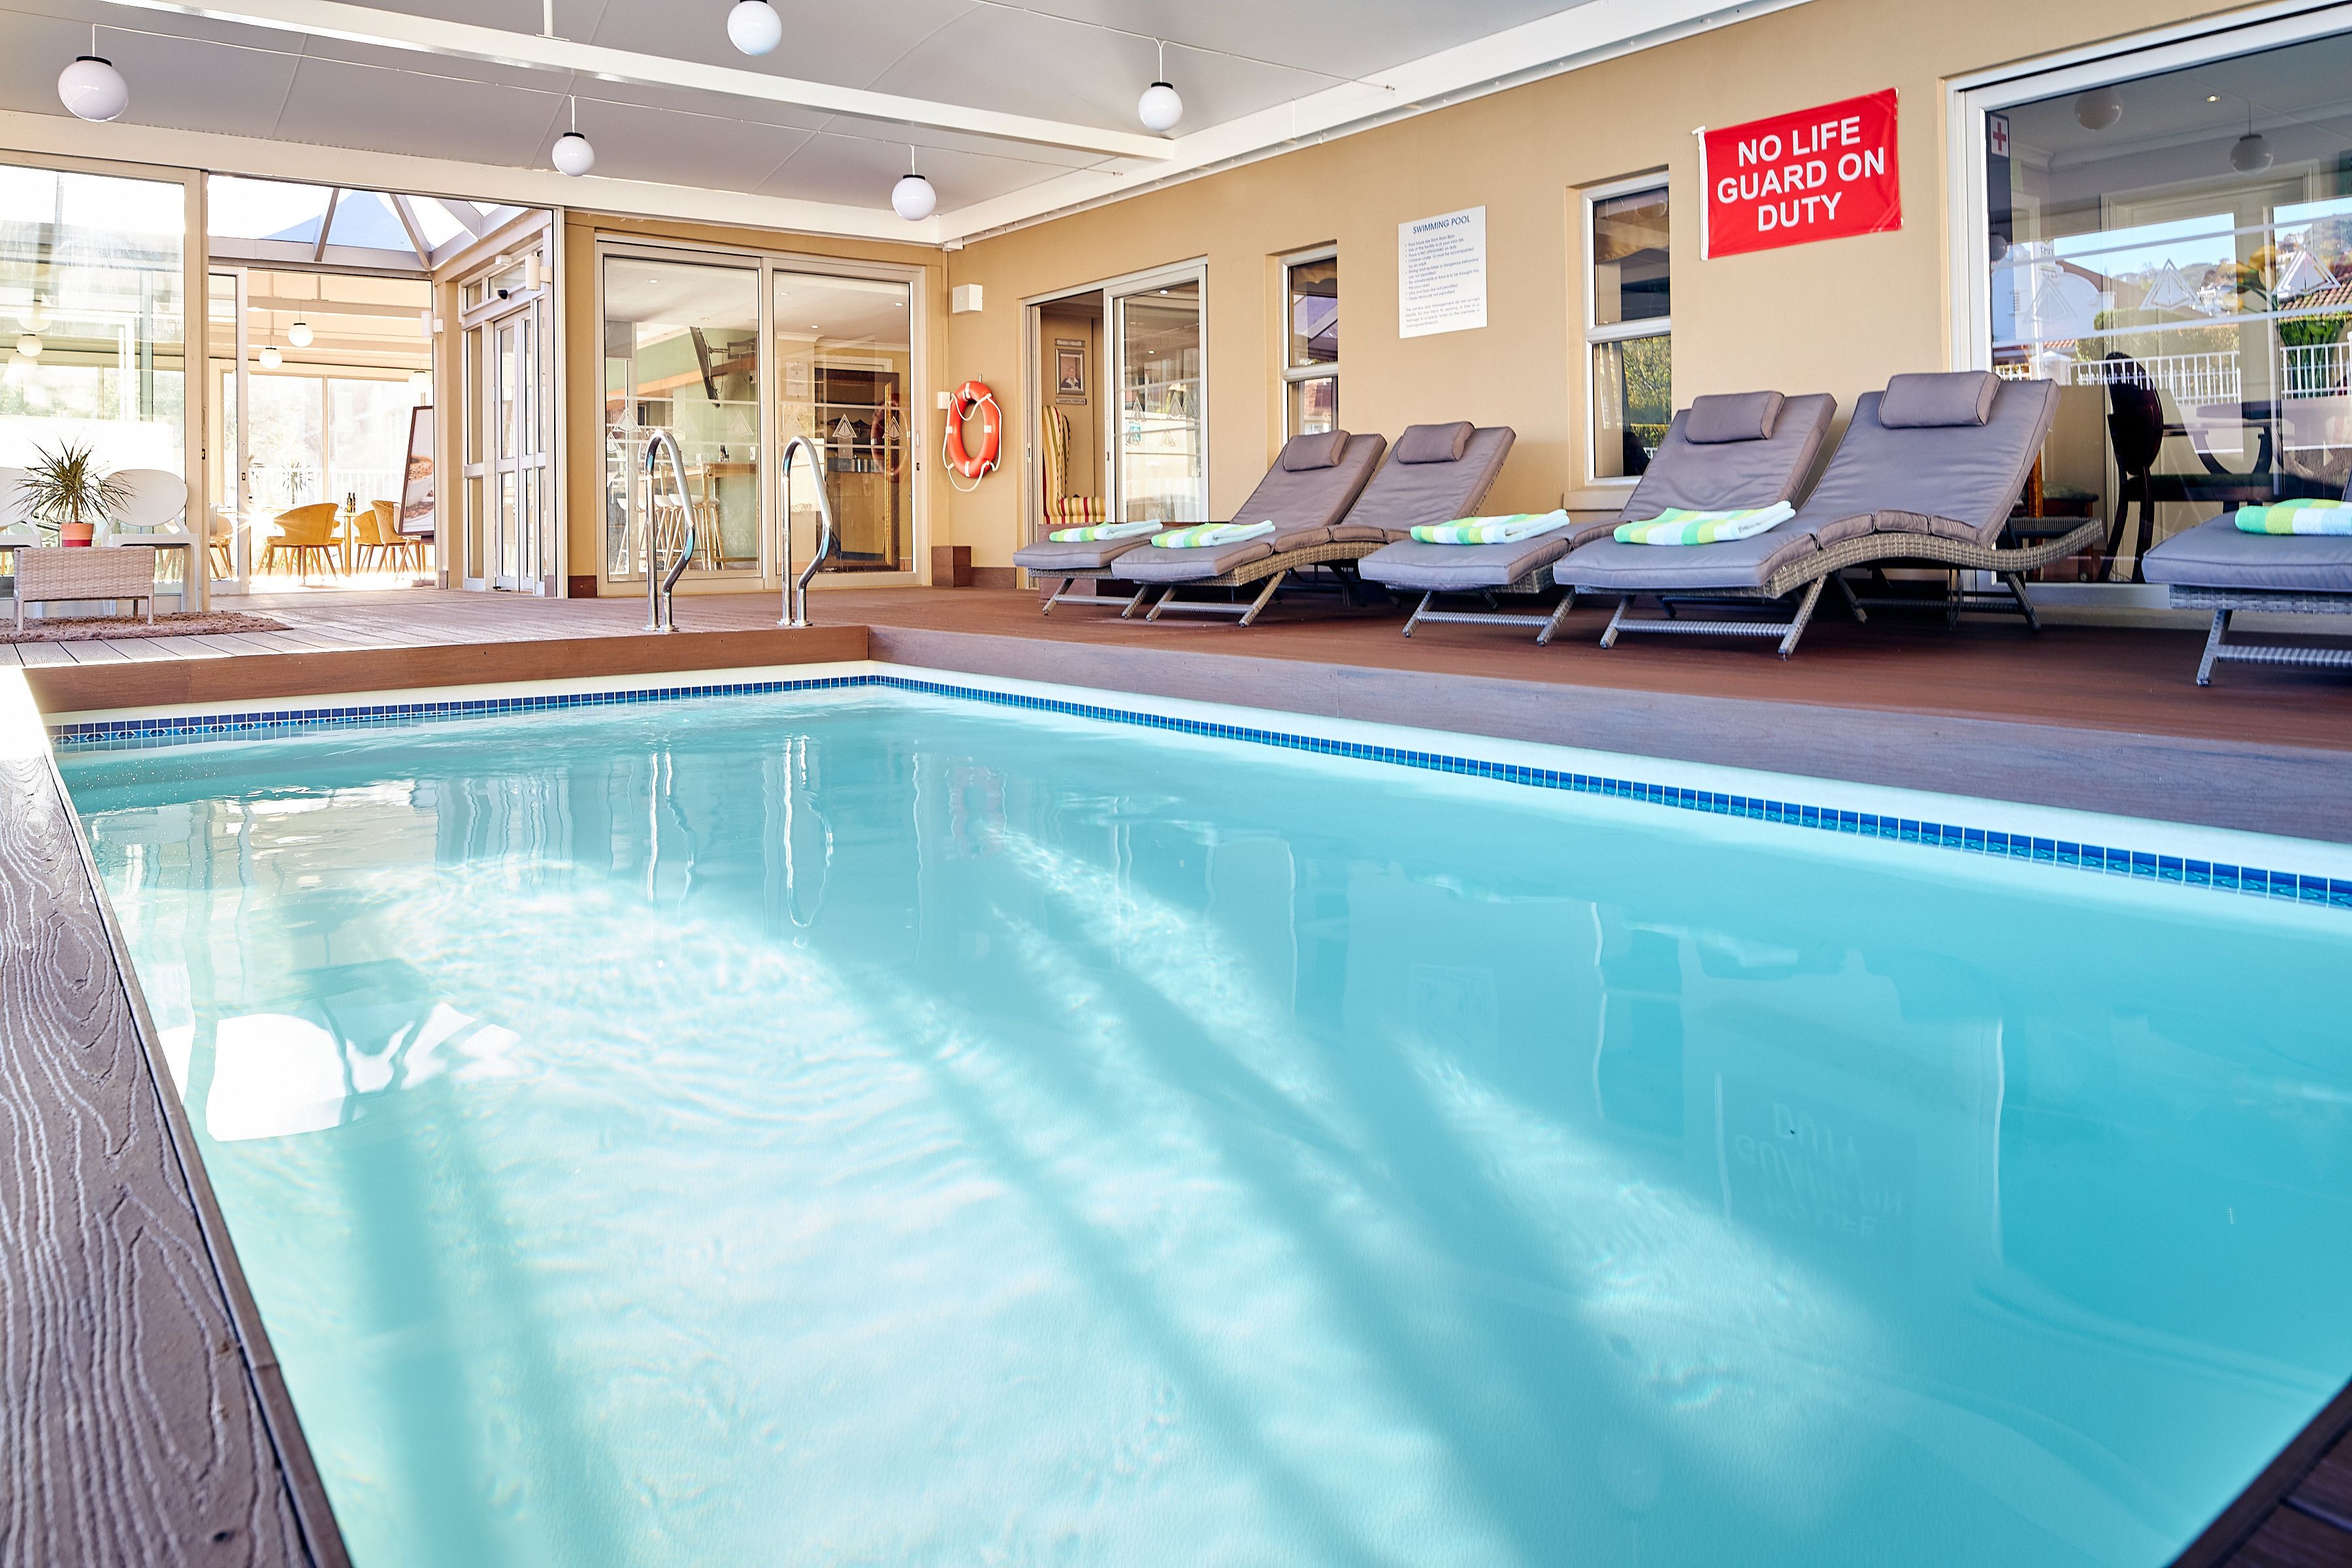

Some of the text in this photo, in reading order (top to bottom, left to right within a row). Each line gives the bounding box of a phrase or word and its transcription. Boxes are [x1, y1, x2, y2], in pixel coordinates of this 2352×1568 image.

[1738, 116, 1860, 167] NO LIFE
[1718, 147, 1884, 203] GUARD ON
[1413, 215, 1470, 234] SWIMMING POOL
[1758, 191, 1842, 231] DUTY
